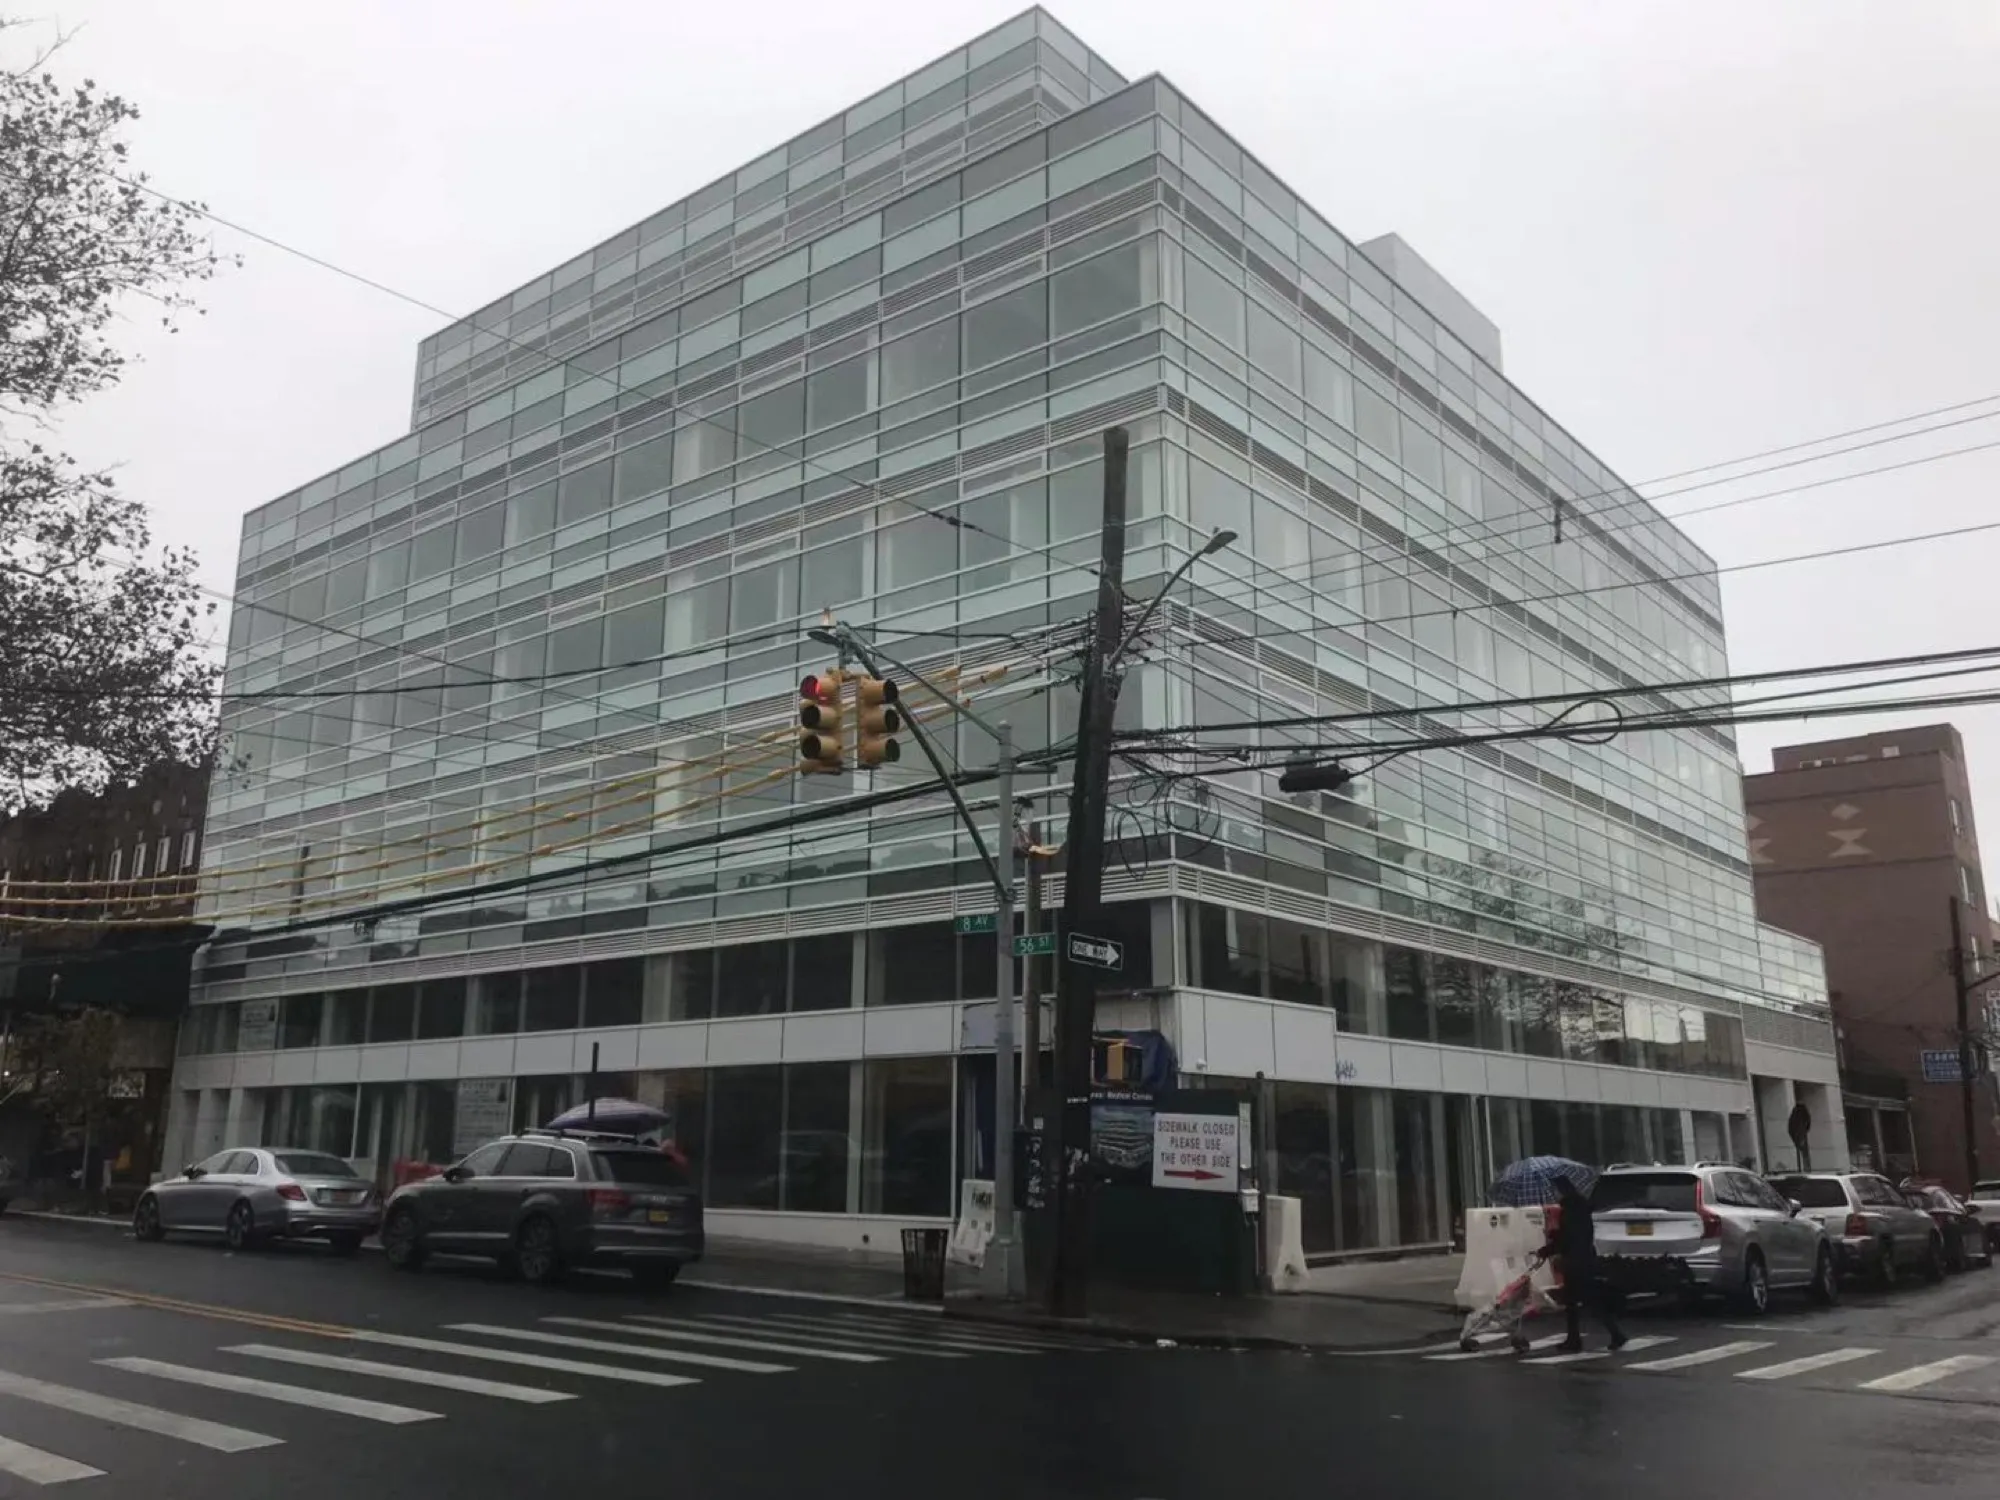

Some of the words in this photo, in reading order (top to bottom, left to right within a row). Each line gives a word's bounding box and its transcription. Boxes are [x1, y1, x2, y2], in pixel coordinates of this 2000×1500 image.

[963, 917, 971, 931] 8
[975, 915, 988, 926] AV
[1019, 938, 1034, 952] 56
[1039, 936, 1049, 947] ST
[1072, 941, 1087, 955] ONE
[1092, 945, 1108, 960] WAY
[1157, 1121, 1198, 1133] SIDEWALK
[1203, 1122, 1235, 1136] CLOSED
[1170, 1136, 1200, 1150] PLEASE
[1204, 1138, 1221, 1150] USE
[1161, 1152, 1176, 1165] THE
[1180, 1153, 1207, 1166] OTHER
[1212, 1155, 1231, 1167] SIDE
